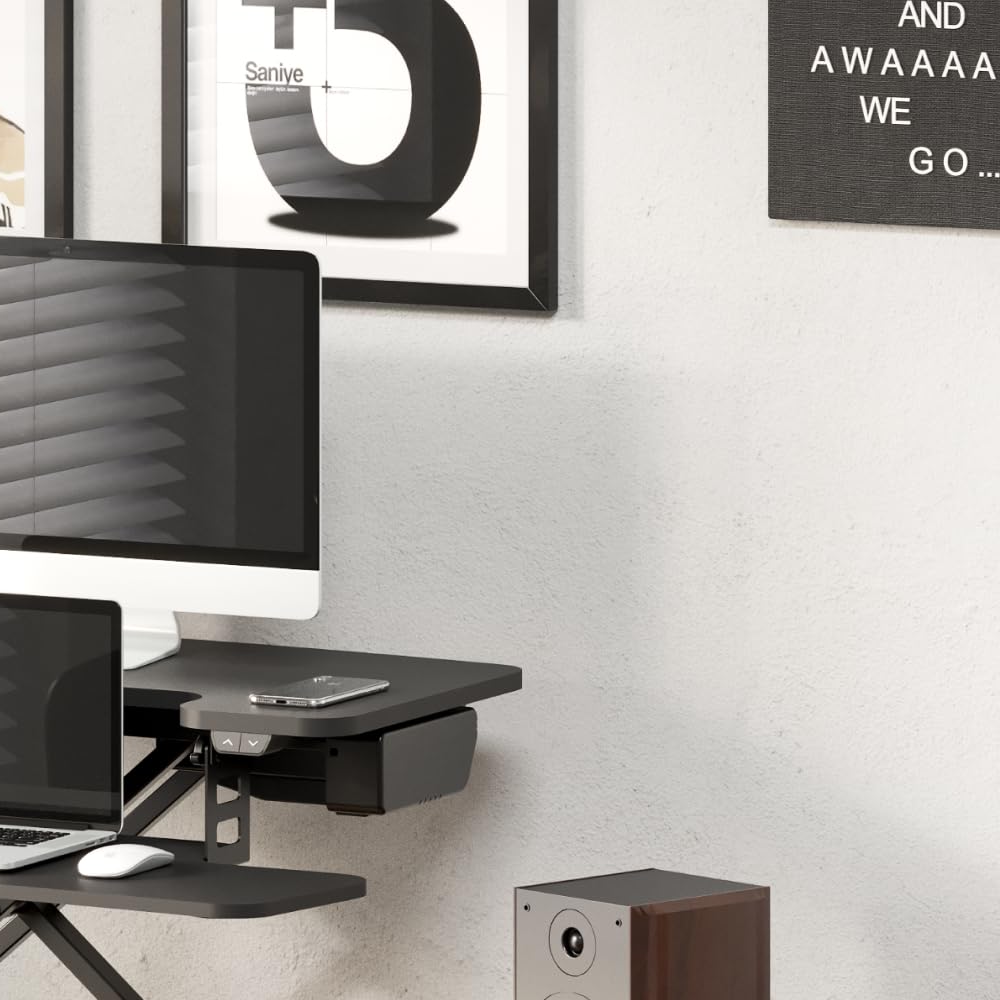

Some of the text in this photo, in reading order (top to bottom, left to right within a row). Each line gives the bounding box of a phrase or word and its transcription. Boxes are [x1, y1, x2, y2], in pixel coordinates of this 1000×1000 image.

[898, 0, 966, 30] AND
[245, 61, 304, 86] Saniye
[859, 95, 912, 126] WE
